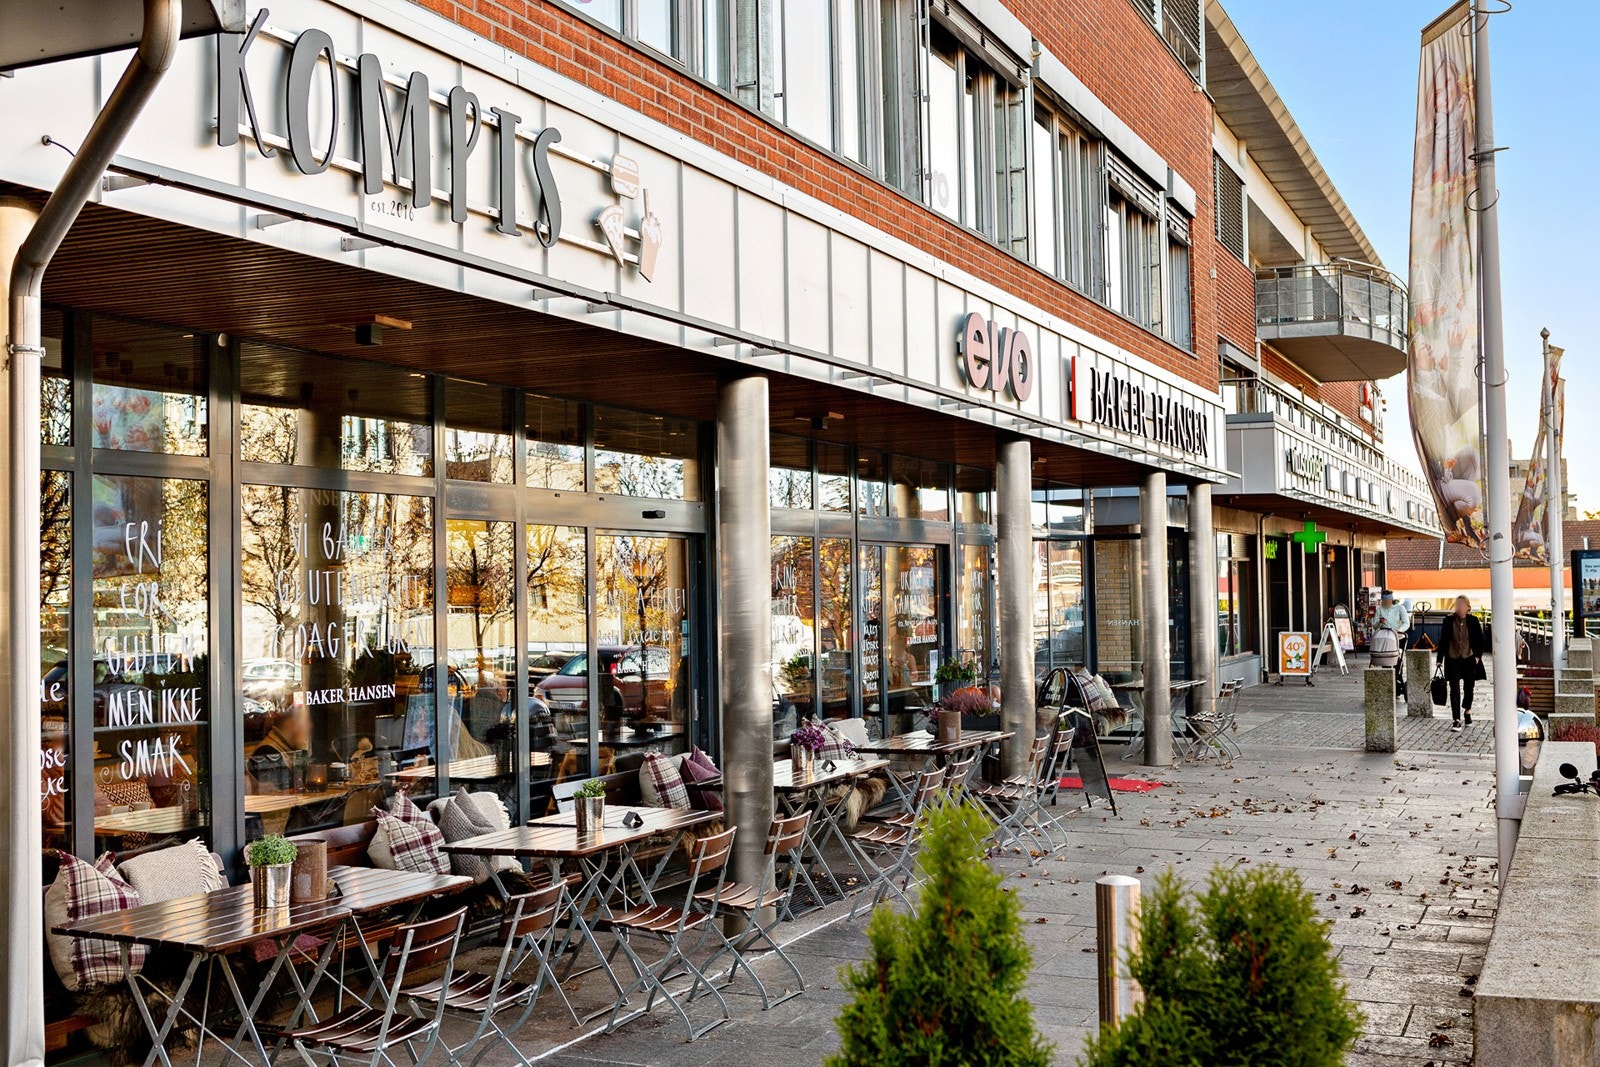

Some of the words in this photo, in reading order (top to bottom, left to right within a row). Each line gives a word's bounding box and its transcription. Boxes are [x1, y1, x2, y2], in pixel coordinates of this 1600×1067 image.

[217, 8, 562, 249] KOMPIS
[963, 312, 1033, 402] evo
[1090, 366, 1149, 438] BAKER
[1150, 392, 1208, 458] HANSEN
[121, 582, 180, 626] FOR
[104, 633, 196, 676] GLUTEN
[298, 619, 375, 660] DAGER
[109, 689, 154, 730] MEN
[305, 688, 346, 706] BAKER
[347, 683, 397, 702] HANSEN
[121, 734, 192, 780] SMAK
